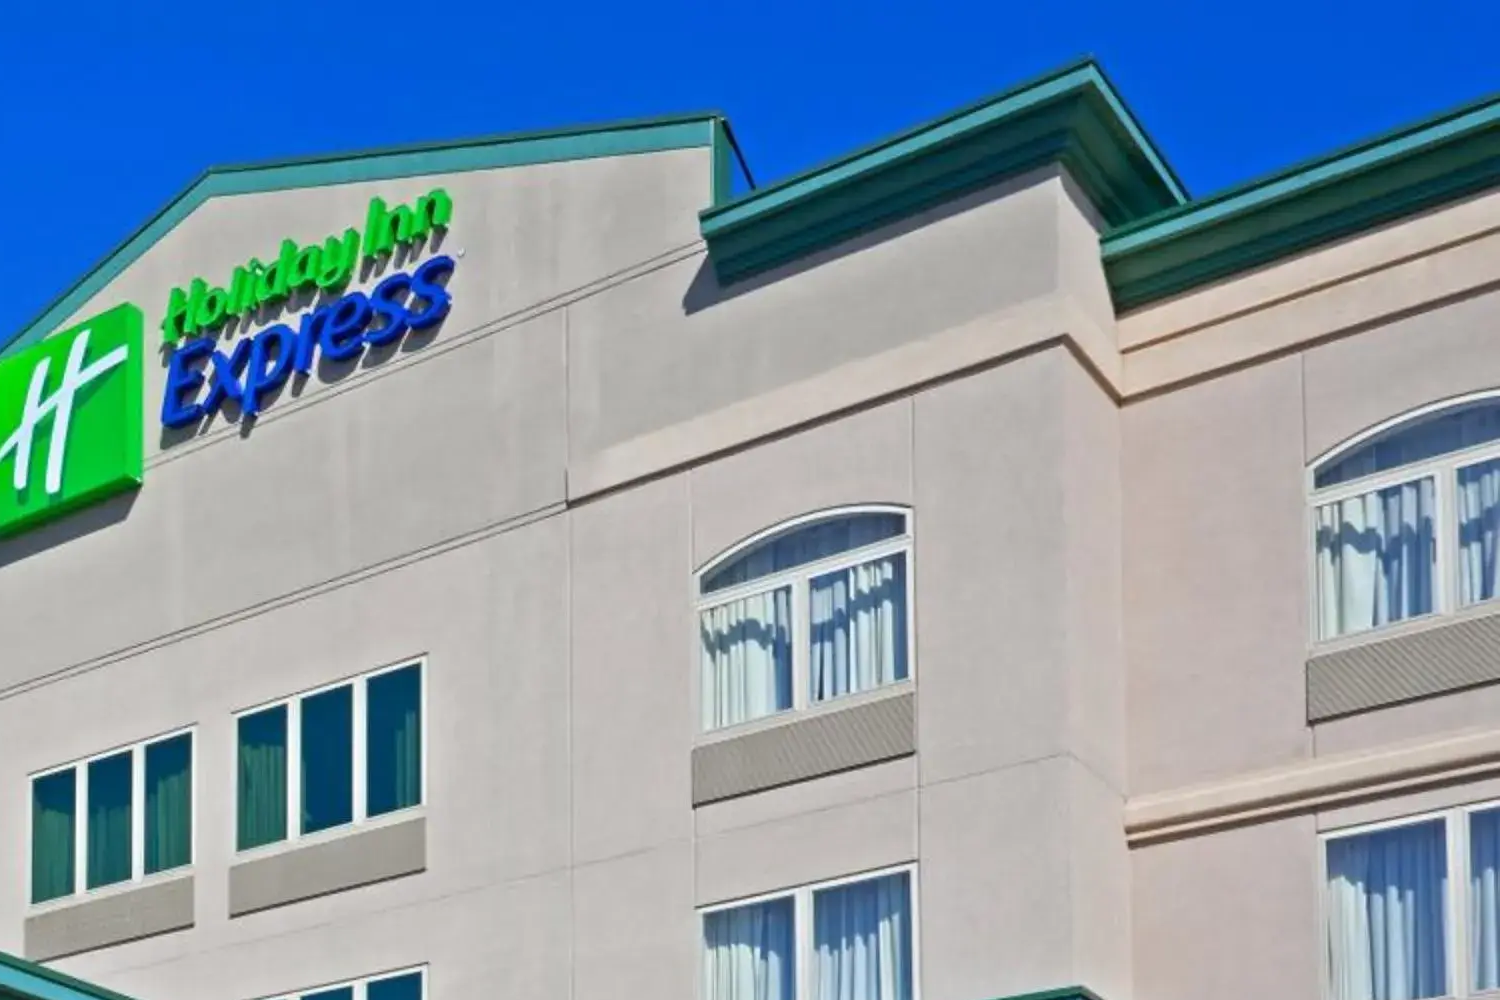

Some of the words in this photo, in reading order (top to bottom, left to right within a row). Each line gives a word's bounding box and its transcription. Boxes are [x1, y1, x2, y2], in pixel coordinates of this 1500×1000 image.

[160, 254, 455, 429] Express
[162, 227, 360, 344] Holiday
[362, 187, 454, 258] Inn
